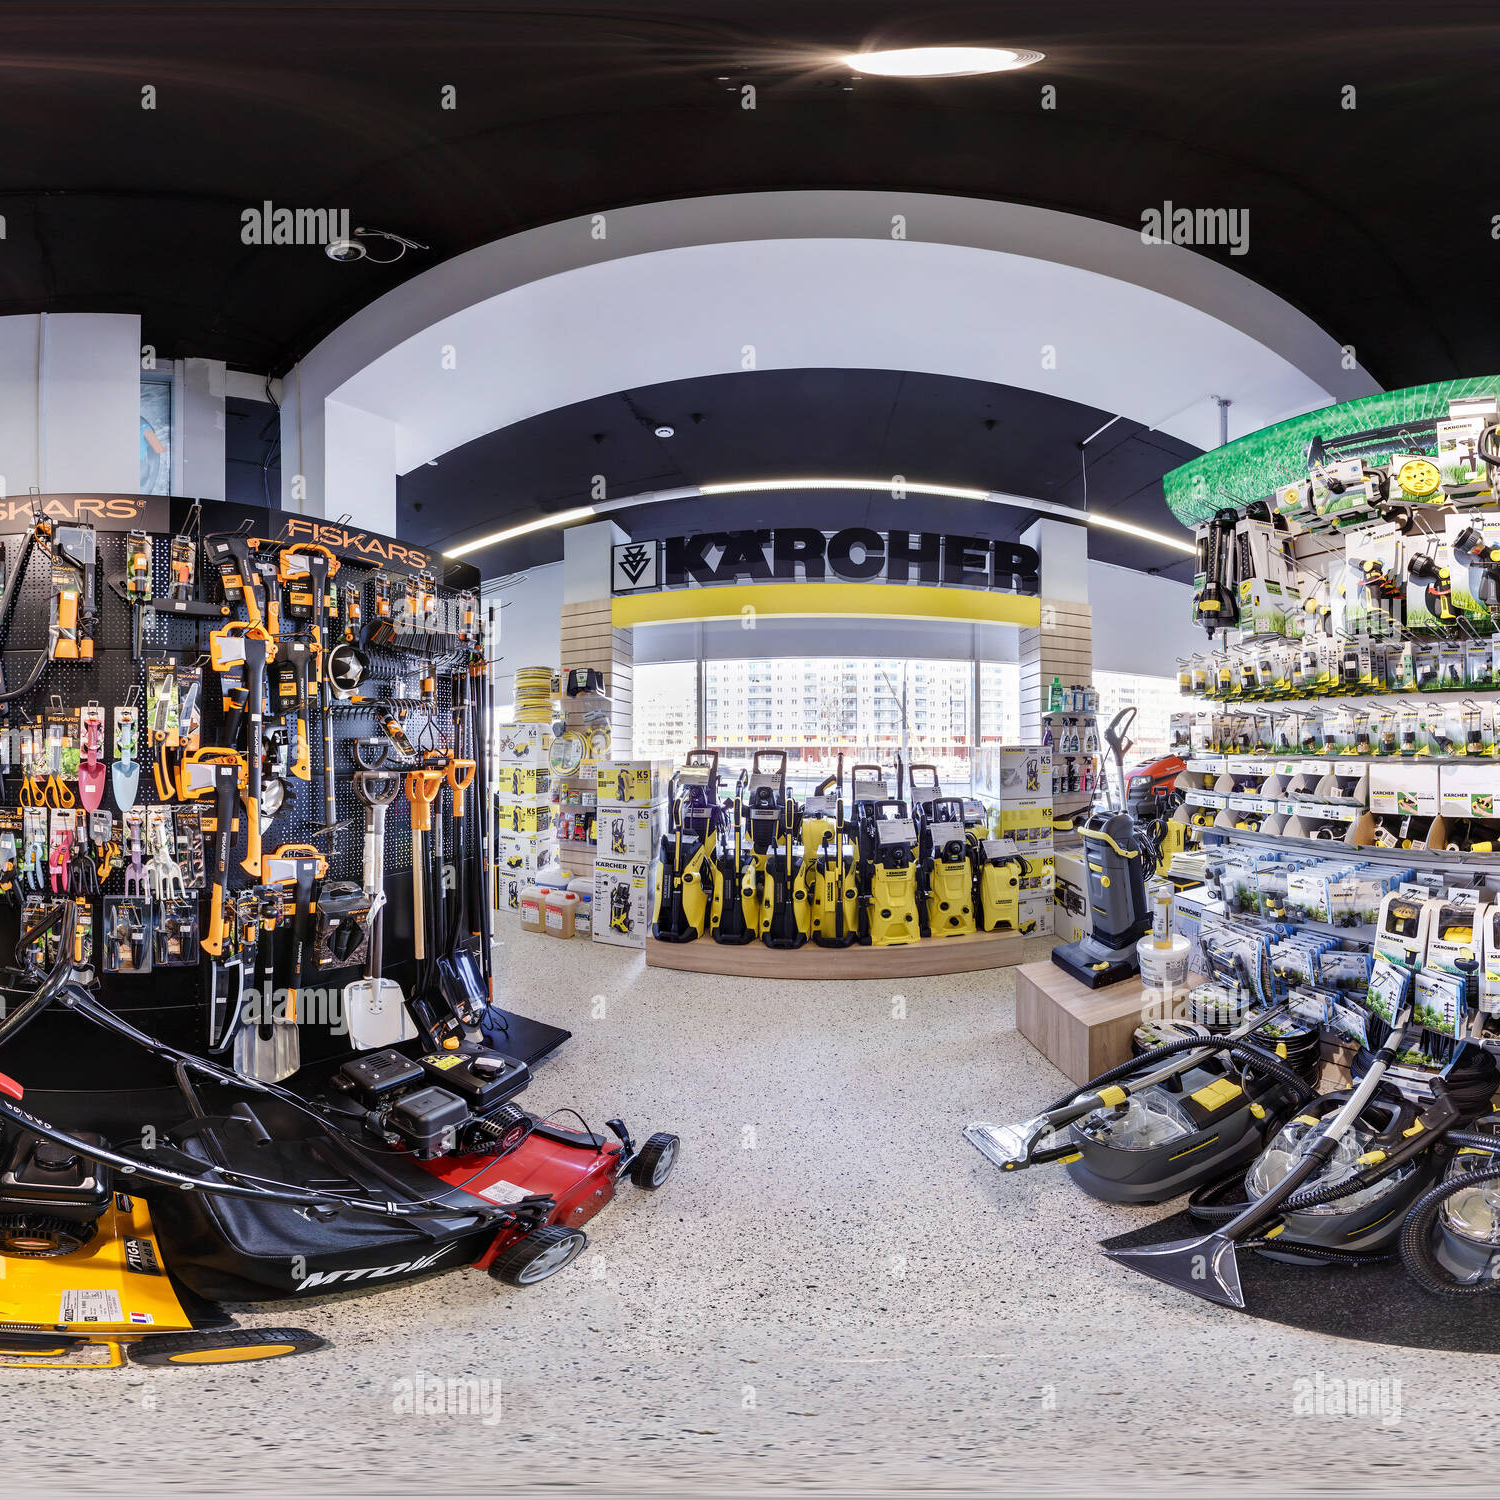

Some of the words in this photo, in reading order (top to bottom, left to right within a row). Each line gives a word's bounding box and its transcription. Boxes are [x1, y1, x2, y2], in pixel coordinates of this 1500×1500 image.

[287, 518, 427, 568] FISKARS
[665, 527, 1040, 597] KÄRCHER
[1040, 755, 1051, 765] K5
[526, 769, 536, 777] K5
[636, 770, 649, 778] K5
[526, 807, 536, 815] K5
[637, 810, 649, 819] K5
[1042, 808, 1053, 816] K5
[595, 861, 628, 870] KÄRCHER
[1043, 857, 1053, 865] K5
[632, 865, 646, 875] K7
[127, 1239, 143, 1272] STIGA
[295, 1261, 412, 1292] MTD
